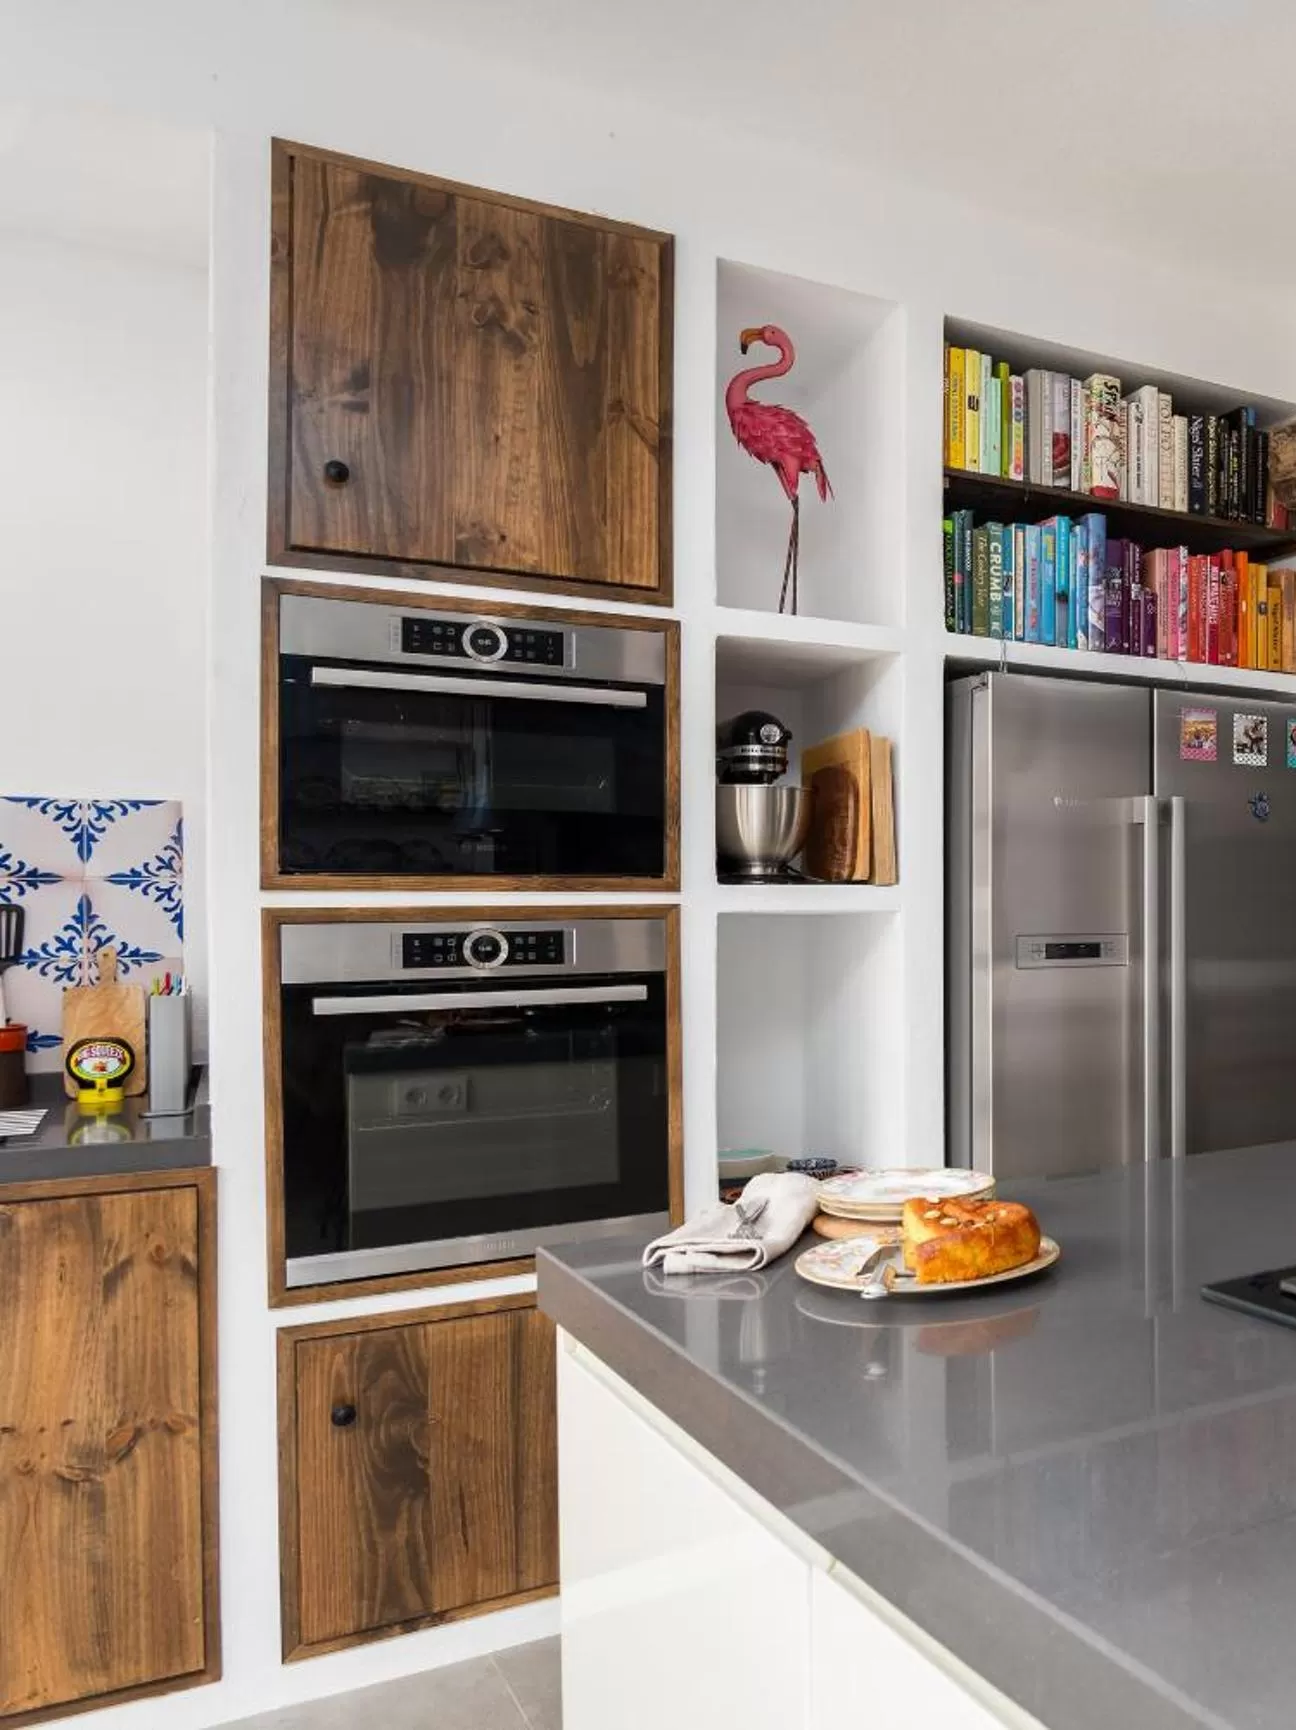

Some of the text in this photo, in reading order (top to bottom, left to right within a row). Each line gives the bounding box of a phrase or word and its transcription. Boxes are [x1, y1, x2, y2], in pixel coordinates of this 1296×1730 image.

[1189, 415, 1203, 445] Nigel
[1191, 446, 1203, 478] Slater
[989, 542, 1002, 601] CRUMB
